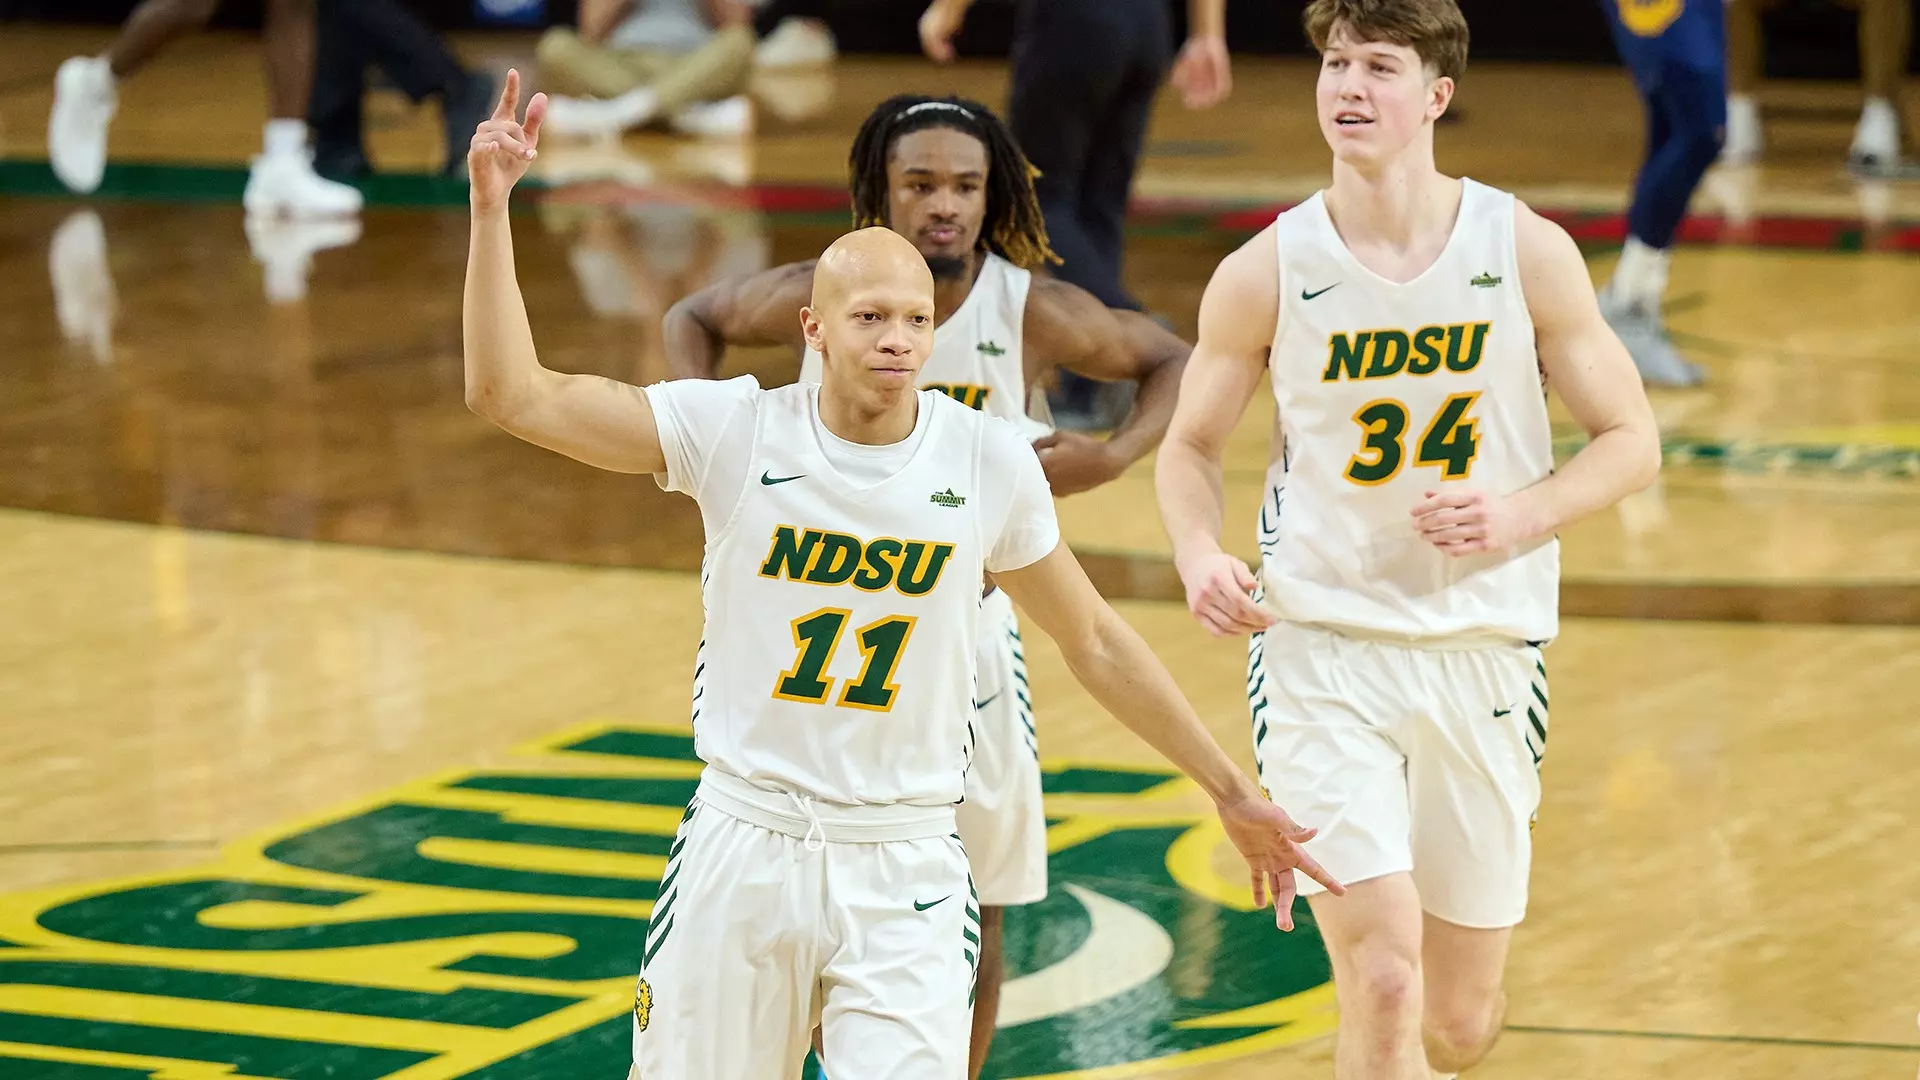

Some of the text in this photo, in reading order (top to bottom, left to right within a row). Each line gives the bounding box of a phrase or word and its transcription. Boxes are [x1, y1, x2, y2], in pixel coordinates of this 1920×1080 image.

[1321, 322, 1491, 383] NDSU
[1342, 391, 1483, 486] 34
[930, 494, 966, 505] SUMMIT
[758, 524, 956, 597] NDSU
[771, 606, 918, 712] 11
